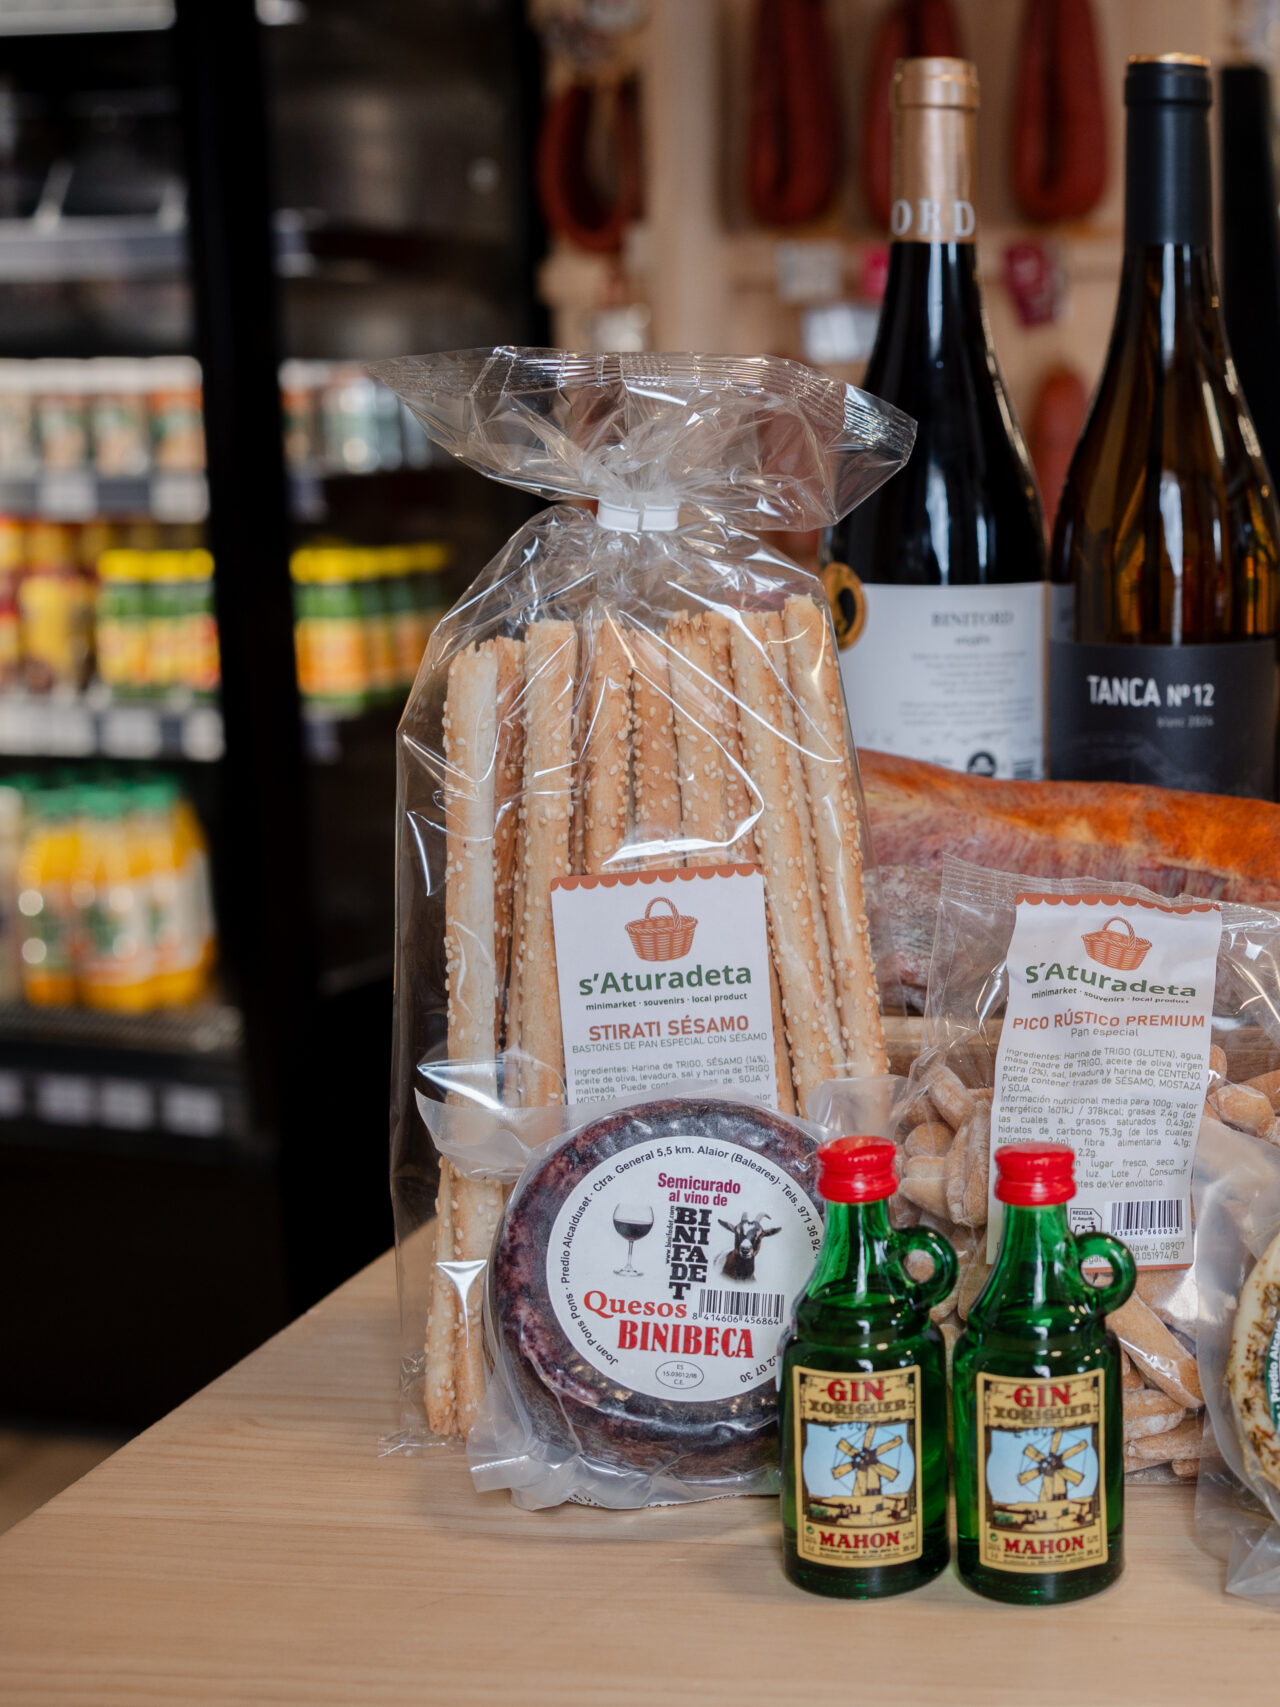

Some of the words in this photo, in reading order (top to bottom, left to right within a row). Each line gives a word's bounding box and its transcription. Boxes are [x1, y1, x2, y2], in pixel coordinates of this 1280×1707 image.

[1087, 675, 1161, 707] TANCA
[578, 964, 752, 996] s'Aturadeta
[1025, 962, 1197, 998] s'Aturadeta
[586, 1000, 636, 1011] minimarket
[643, 997, 685, 1007] souvenirs
[691, 994, 712, 1003] local
[714, 992, 748, 1003] product
[1031, 987, 1077, 999] minimarket
[1084, 990, 1125, 1003] souvenirs
[1131, 995, 1153, 1003] local
[589, 1022, 661, 1041] STIRATI
[668, 1015, 749, 1036] SÉSAMO
[1012, 1015, 1049, 1030] PICO
[1054, 1008, 1120, 1028] RÚSTICO
[1126, 1015, 1205, 1028] PREMIUM
[1071, 1027, 1090, 1038] Pan
[1093, 1027, 1139, 1038] especial
[572, 1042, 622, 1053] BASTONES
[624, 1041, 635, 1050] DE
[638, 1039, 658, 1049] PAN
[661, 1036, 704, 1048] ESPECIAL
[707, 1034, 727, 1044] CON
[1064, 1050, 1090, 1060] Harina
[1104, 1047, 1131, 1056] TRIGO
[631, 1063, 660, 1072] Harina
[663, 1062, 673, 1070] de
[706, 1056, 743, 1066] SÉSAMO
[1003, 1064, 1026, 1073] extra
[1069, 1068, 1105, 1078] levadura
[1114, 1067, 1142, 1076] harina
[1032, 1060, 1061, 1069] madre
[1106, 1058, 1133, 1066] aceite
[1150, 1059, 1172, 1068] oliva
[1175, 1061, 1203, 1072] virgen
[575, 1077, 601, 1086] aceite
[603, 1075, 613, 1084] de
[681, 1069, 694, 1079] sal
[696, 1070, 702, 1079] y
[703, 1067, 730, 1077] harina
[732, 1065, 742, 1074] de
[744, 1064, 770, 1073] TRIGO
[621, 1082, 647, 1092] Puede
[738, 1074, 762, 1084] SOJA
[1002, 1073, 1029, 1083] Puede
[1031, 1076, 1069, 1088] contener
[1072, 1078, 1099, 1087] trazas
[1101, 1096, 1128, 1106] media
[1176, 1101, 1199, 1110] valor
[1127, 1108, 1156, 1117] grasas
[1020, 1116, 1049, 1124] cuales
[1075, 1118, 1107, 1127] grasos
[656, 1146, 673, 1158] 5,5
[675, 1145, 695, 1155] km.
[697, 1145, 730, 1159] Alaior
[615, 1150, 655, 1174] General
[1090, 1159, 1115, 1169] lugar
[1149, 1167, 1188, 1177] Consumir
[592, 1173, 616, 1192] Ctra.
[657, 1172, 741, 1195] Semicurado
[668, 1189, 681, 1203] al
[683, 1190, 710, 1205] vino
[713, 1193, 729, 1207] de
[781, 1183, 798, 1207] Tels.
[563, 1195, 593, 1249] Alcaiduset
[674, 1206, 713, 1227] BI
[797, 1205, 813, 1224] 971
[672, 1225, 711, 1245] NI
[806, 1224, 819, 1237] 36
[671, 1244, 709, 1264] FA
[560, 1250, 571, 1284] Predio
[669, 1262, 708, 1283] DE
[668, 1281, 692, 1301] T
[566, 1292, 581, 1320] Pons
[583, 1290, 688, 1319] Quesos
[692, 1312, 698, 1320] 8
[703, 1314, 739, 1324] 414606
[744, 1316, 780, 1326] 456864
[577, 1320, 598, 1347] Pons
[617, 1319, 755, 1359] BINIBECA
[596, 1344, 619, 1365] Joan
[739, 1371, 754, 1383] 30
[755, 1363, 768, 1376] 07
[827, 1379, 885, 1402] GIN
[1013, 1384, 1071, 1408] GIN
[808, 1398, 907, 1415] XORIGUER
[993, 1403, 1091, 1421] XORIGUER
[819, 1530, 900, 1549] MAHON
[1003, 1534, 1085, 1554] MAHON
